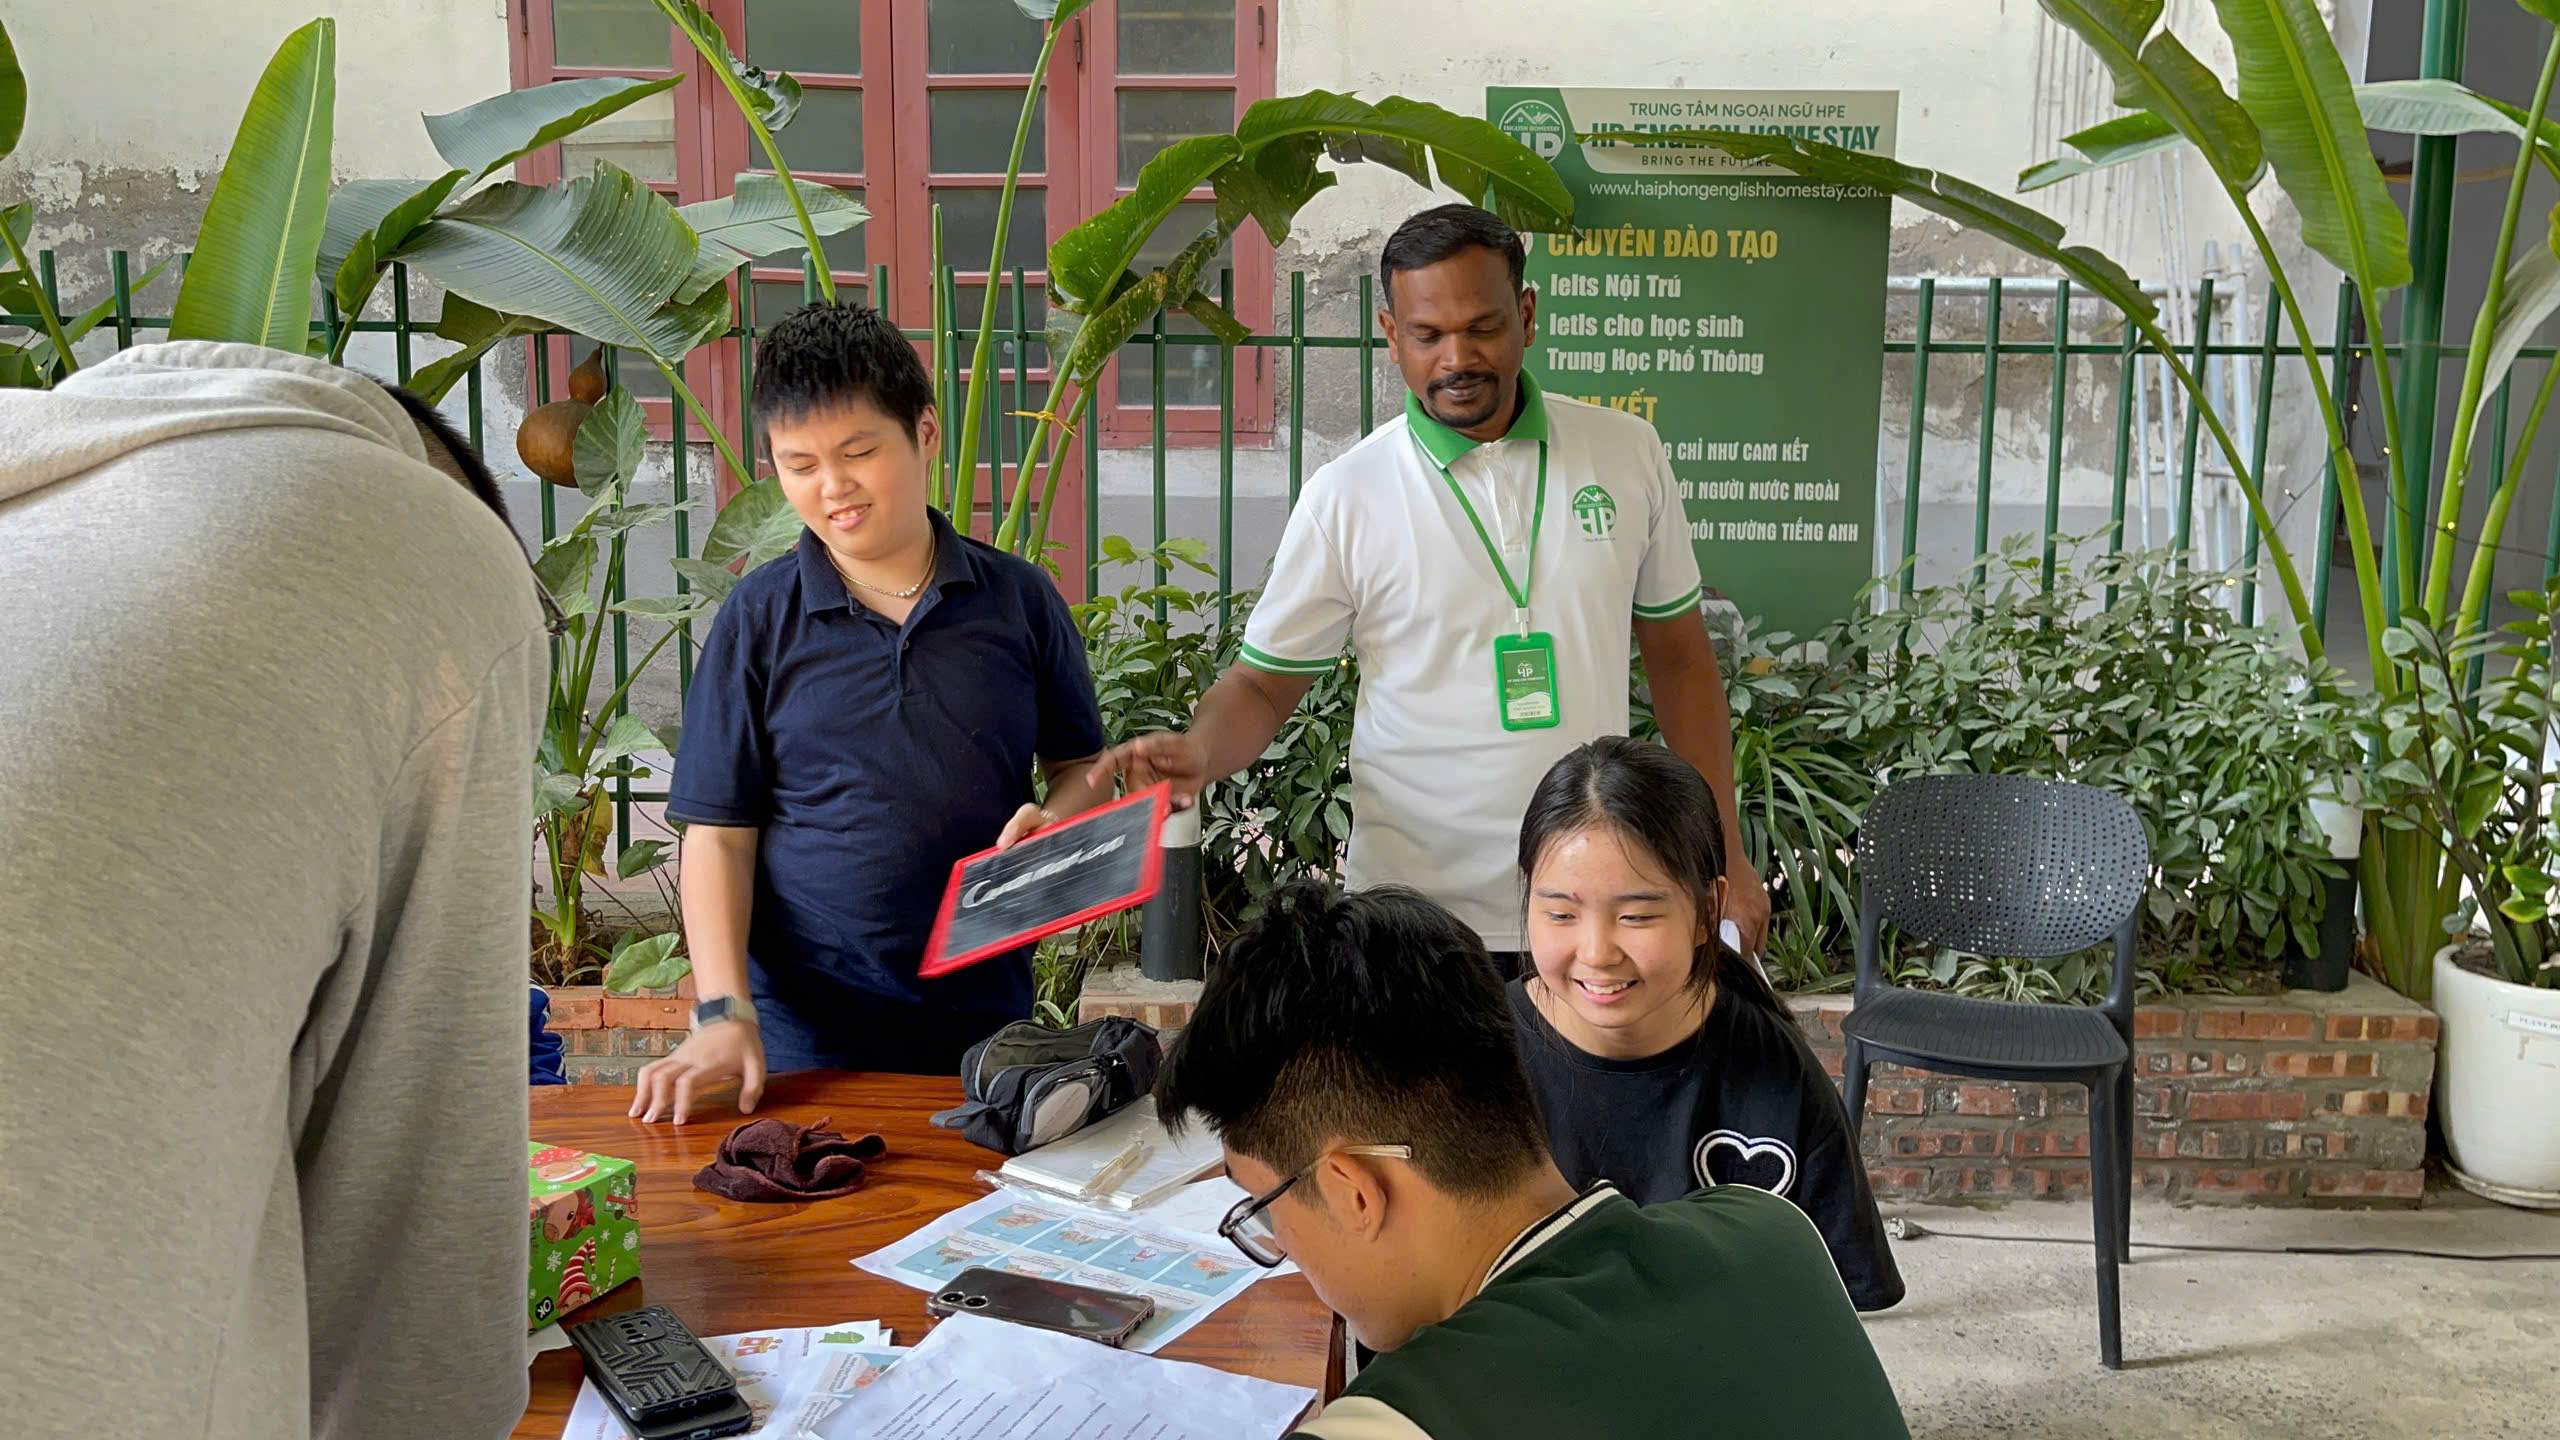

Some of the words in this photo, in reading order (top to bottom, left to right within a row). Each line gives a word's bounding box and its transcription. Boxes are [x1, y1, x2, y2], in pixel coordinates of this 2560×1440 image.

[1629, 102, 1682, 116] TRUNG
[1686, 100, 1718, 117] TÂM
[1722, 103, 1774, 121] NGOẠI
[1778, 101, 1813, 118] NGỮ
[1816, 105, 1846, 118] HPE
[1642, 156, 1684, 167] BRING
[1689, 156, 1715, 167] THE
[1663, 224, 1719, 258] ĐÀO
[1727, 230, 1778, 264] TẠO
[1550, 274, 1599, 297] Ielts
[1605, 274, 1641, 301] Nội
[1646, 274, 1682, 298] Trú
[1603, 314, 1644, 337] cho
[1650, 314, 1690, 341] học
[1696, 315, 1744, 338] sinh
[1547, 347, 1606, 374] Trung
[1612, 348, 1651, 375] Học
[1656, 344, 1695, 373] Phổ
[1701, 349, 1765, 375] Thông
[1677, 437, 1703, 461] CHỈ
[1707, 442, 1740, 461] NHƯ
[1743, 442, 1778, 462] CAM
[1782, 437, 1809, 462] KẾT
[1676, 478, 1694, 500] ỚI
[1699, 478, 1744, 500] NGƯỜI
[1749, 478, 1790, 501] NƯỚC
[1794, 479, 1840, 501] NGOÀI
[1573, 508, 1616, 537] HP
[1719, 519, 1777, 541] TRƯỜNG
[1782, 516, 1824, 542] TIẾNG
[1828, 523, 1858, 542] ANH
[1517, 667, 1533, 678] HP
[537, 1299, 552, 1319] OK
